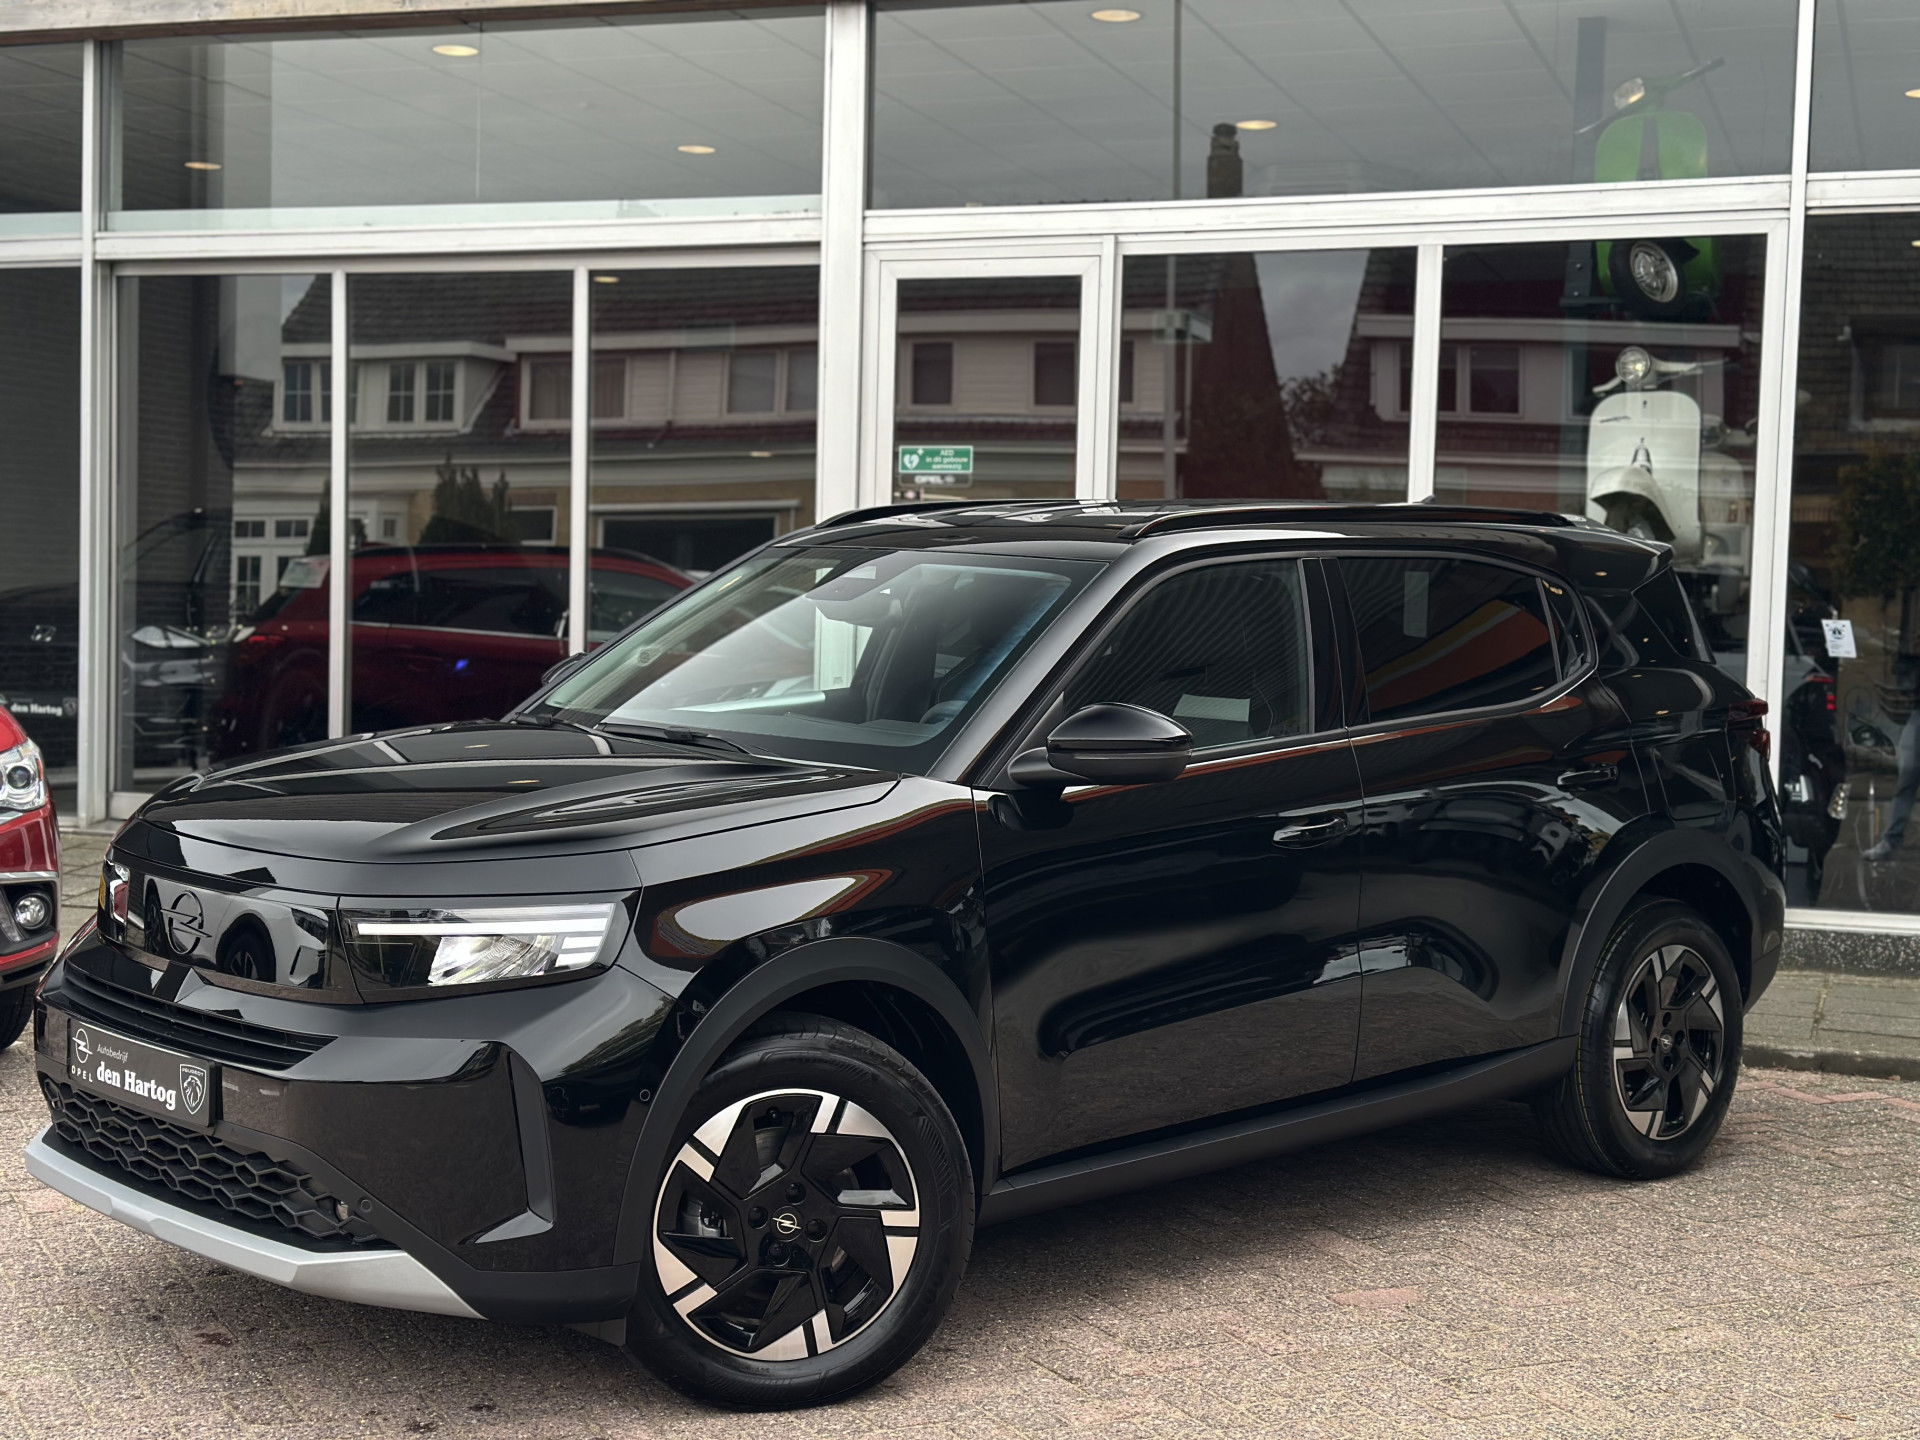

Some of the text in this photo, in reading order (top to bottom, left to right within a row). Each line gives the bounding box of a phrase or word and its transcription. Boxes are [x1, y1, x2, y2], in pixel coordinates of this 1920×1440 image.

[97, 1044, 128, 1063] Autobedrijf
[71, 1065, 93, 1083] OPEL
[97, 1061, 177, 1111] den Hartog
